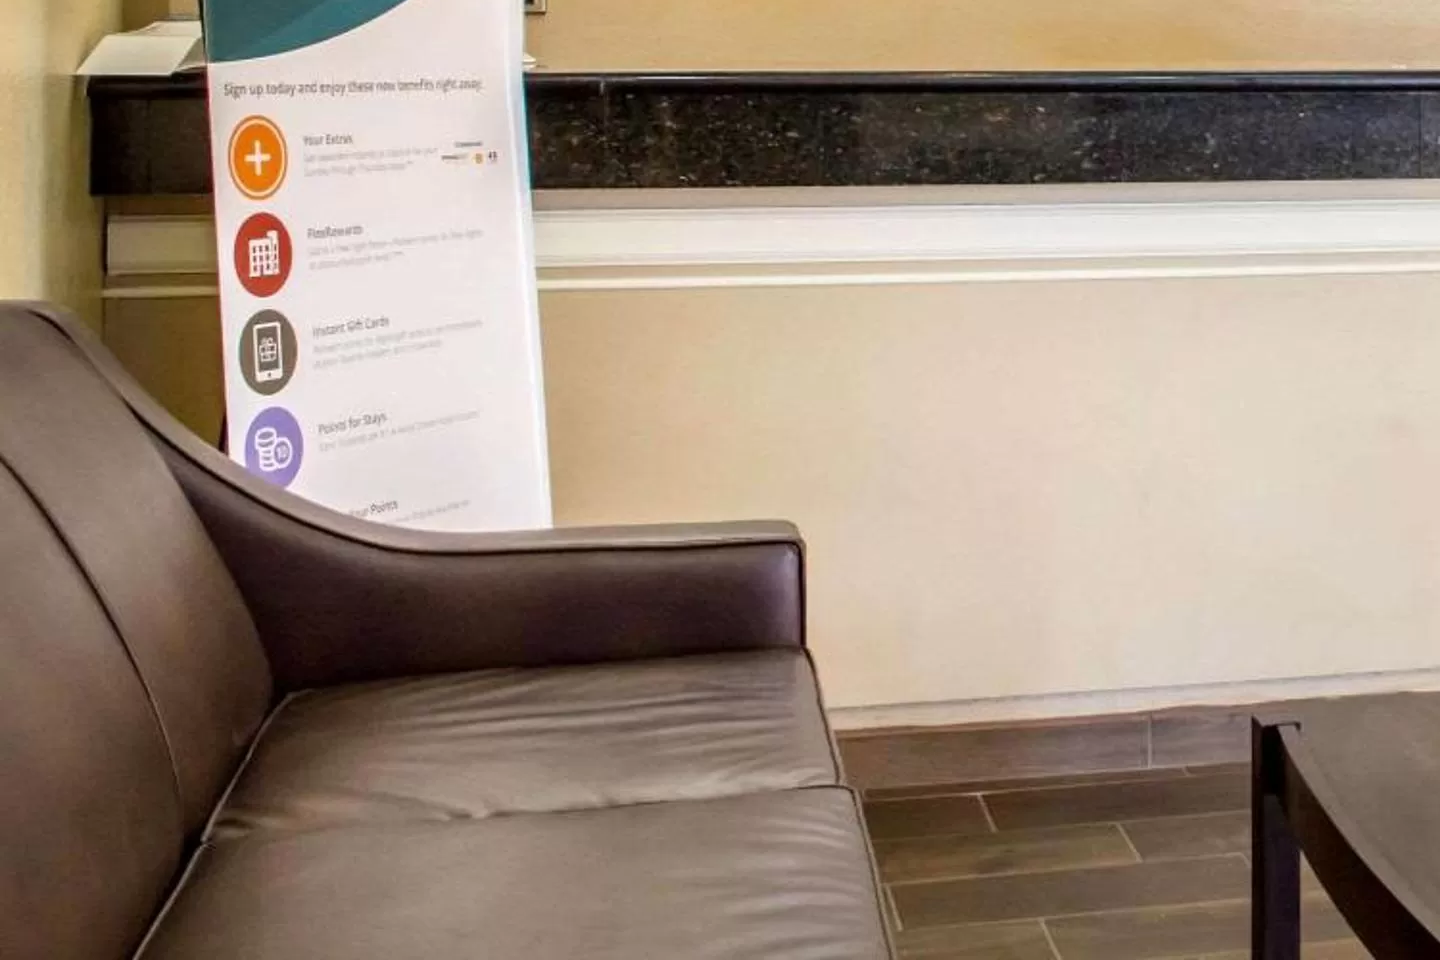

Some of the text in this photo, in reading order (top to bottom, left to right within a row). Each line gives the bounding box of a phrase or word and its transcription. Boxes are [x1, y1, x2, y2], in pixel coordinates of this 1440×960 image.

[223, 82, 246, 100] Sign
[249, 83, 264, 99] up
[266, 81, 296, 97] today
[298, 81, 318, 93] and
[319, 80, 346, 97] enjoy
